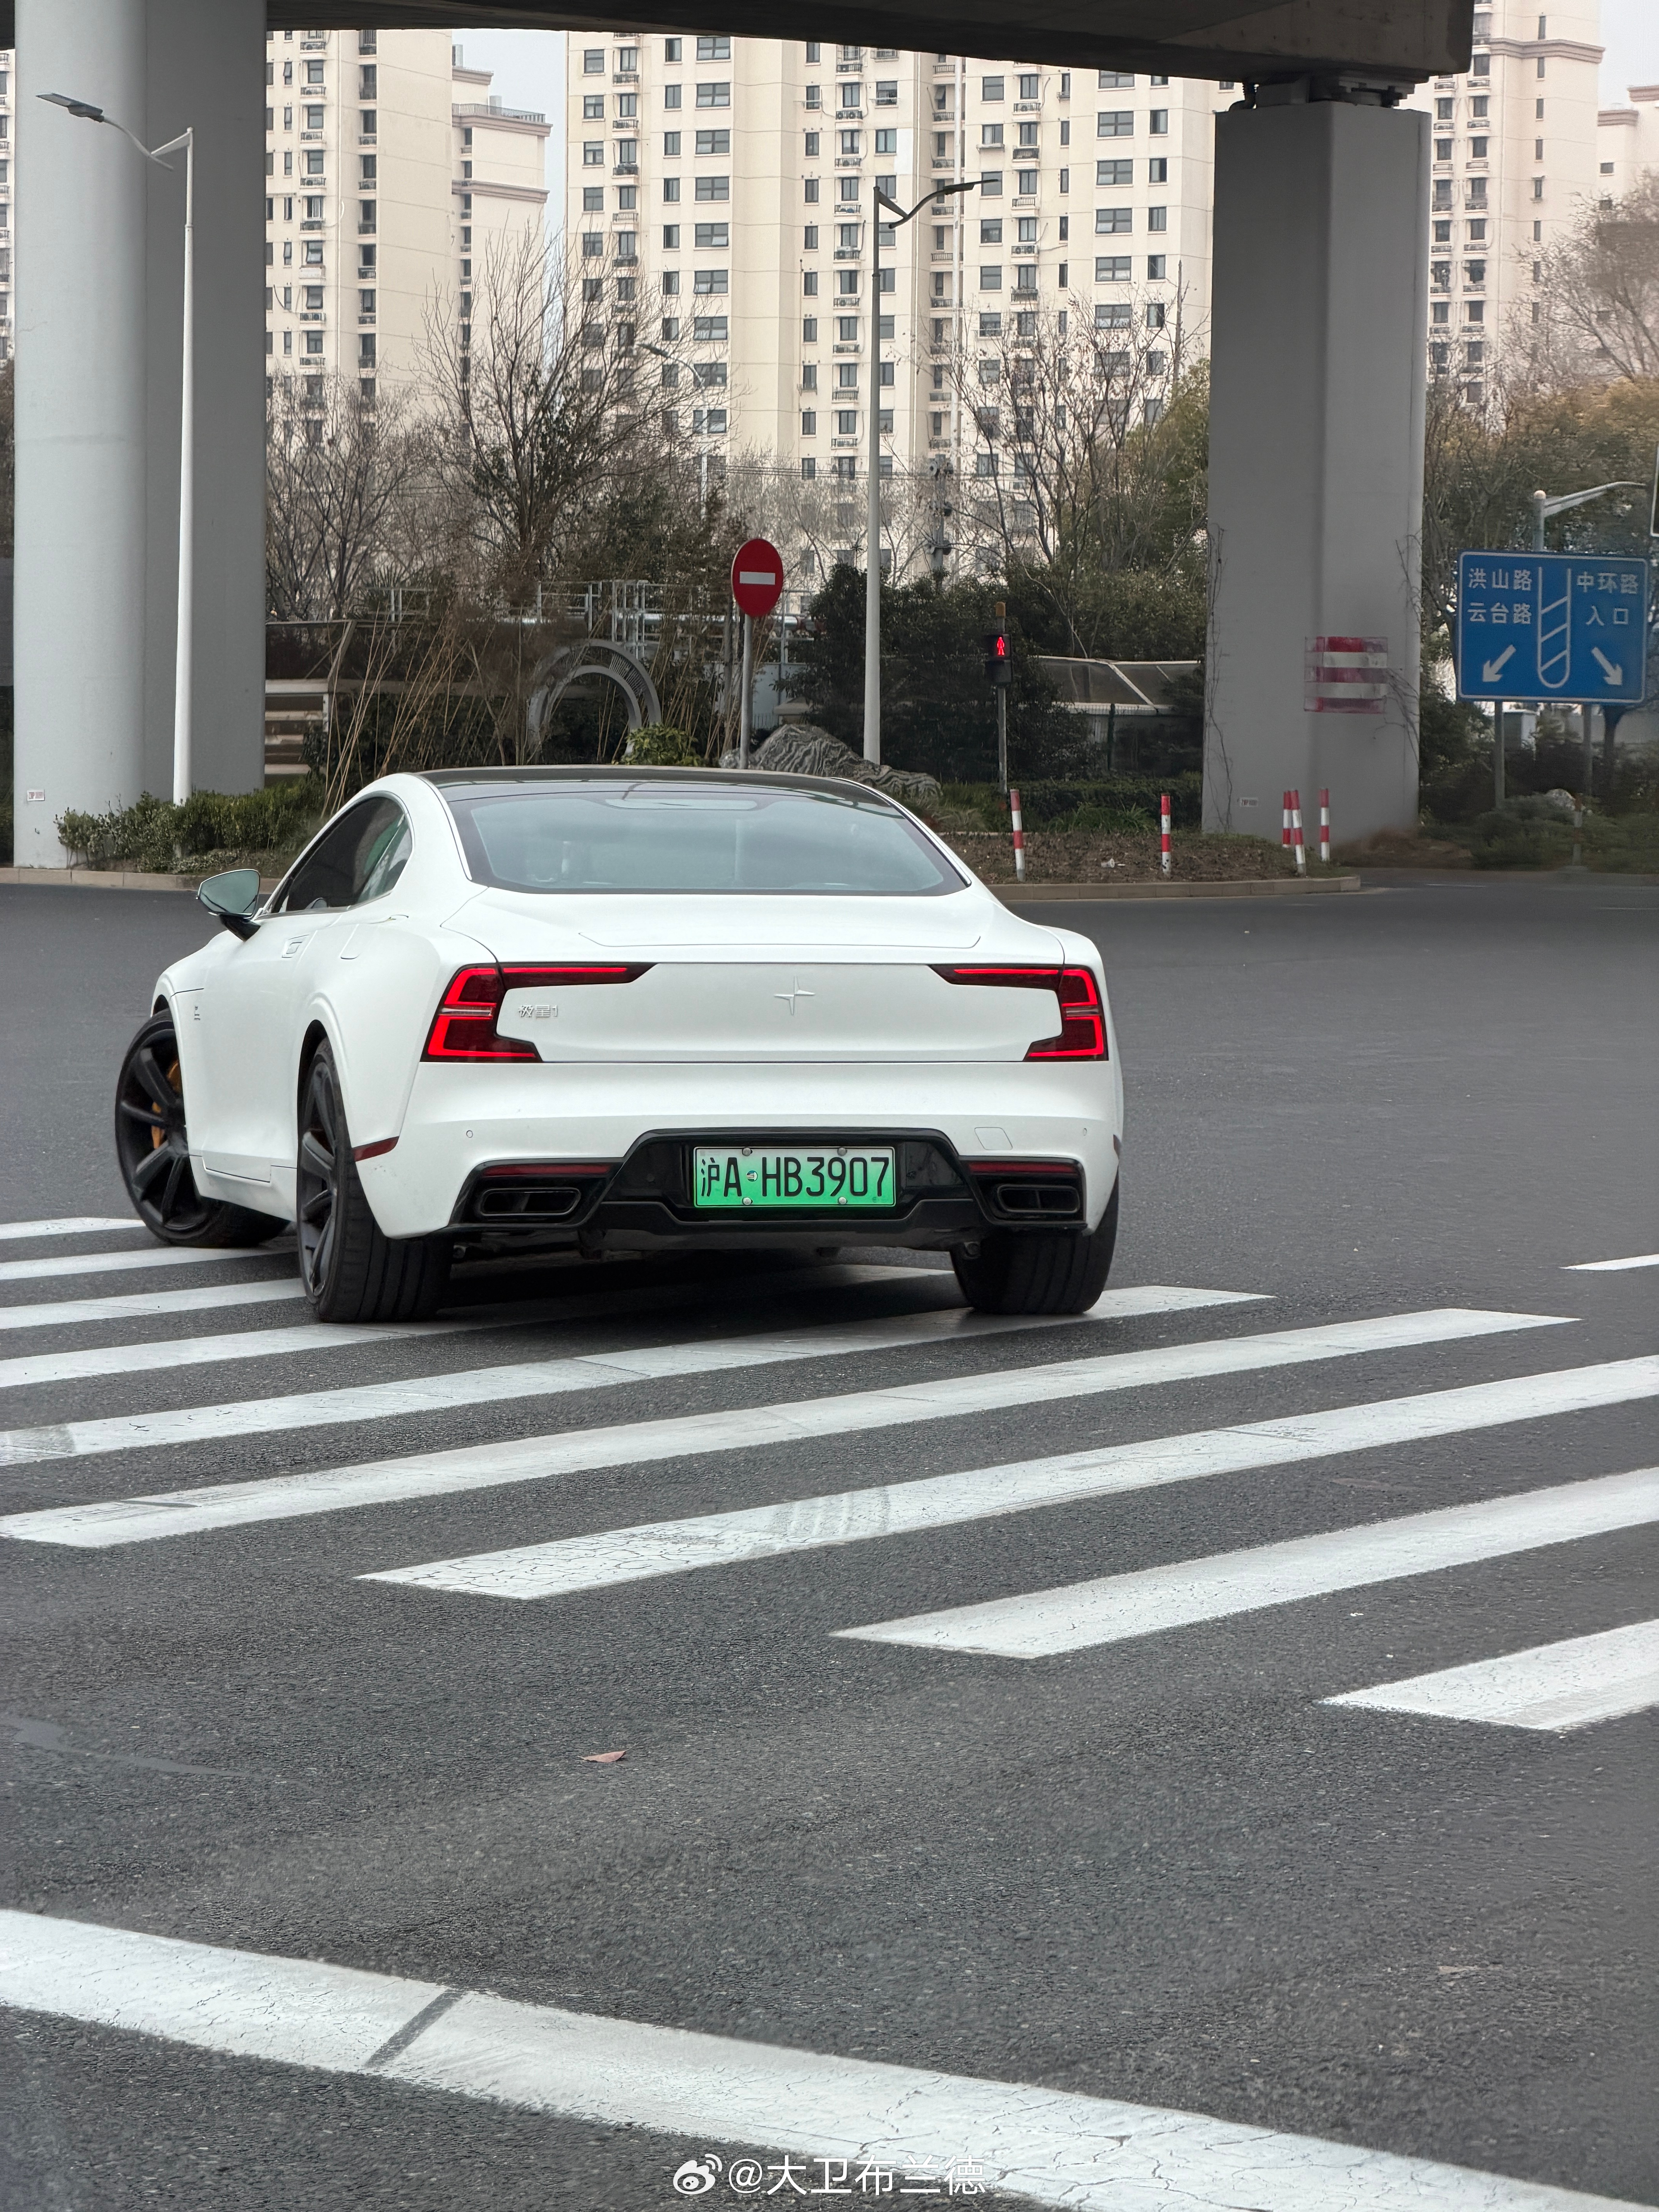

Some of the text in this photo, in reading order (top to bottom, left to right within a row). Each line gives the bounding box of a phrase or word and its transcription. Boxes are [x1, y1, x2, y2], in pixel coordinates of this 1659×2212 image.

[1468, 568, 1532, 591] 洪山路
[1577, 571, 1638, 594] 中环路
[1467, 603, 1532, 624] 云台路
[1586, 606, 1629, 626] 入口
